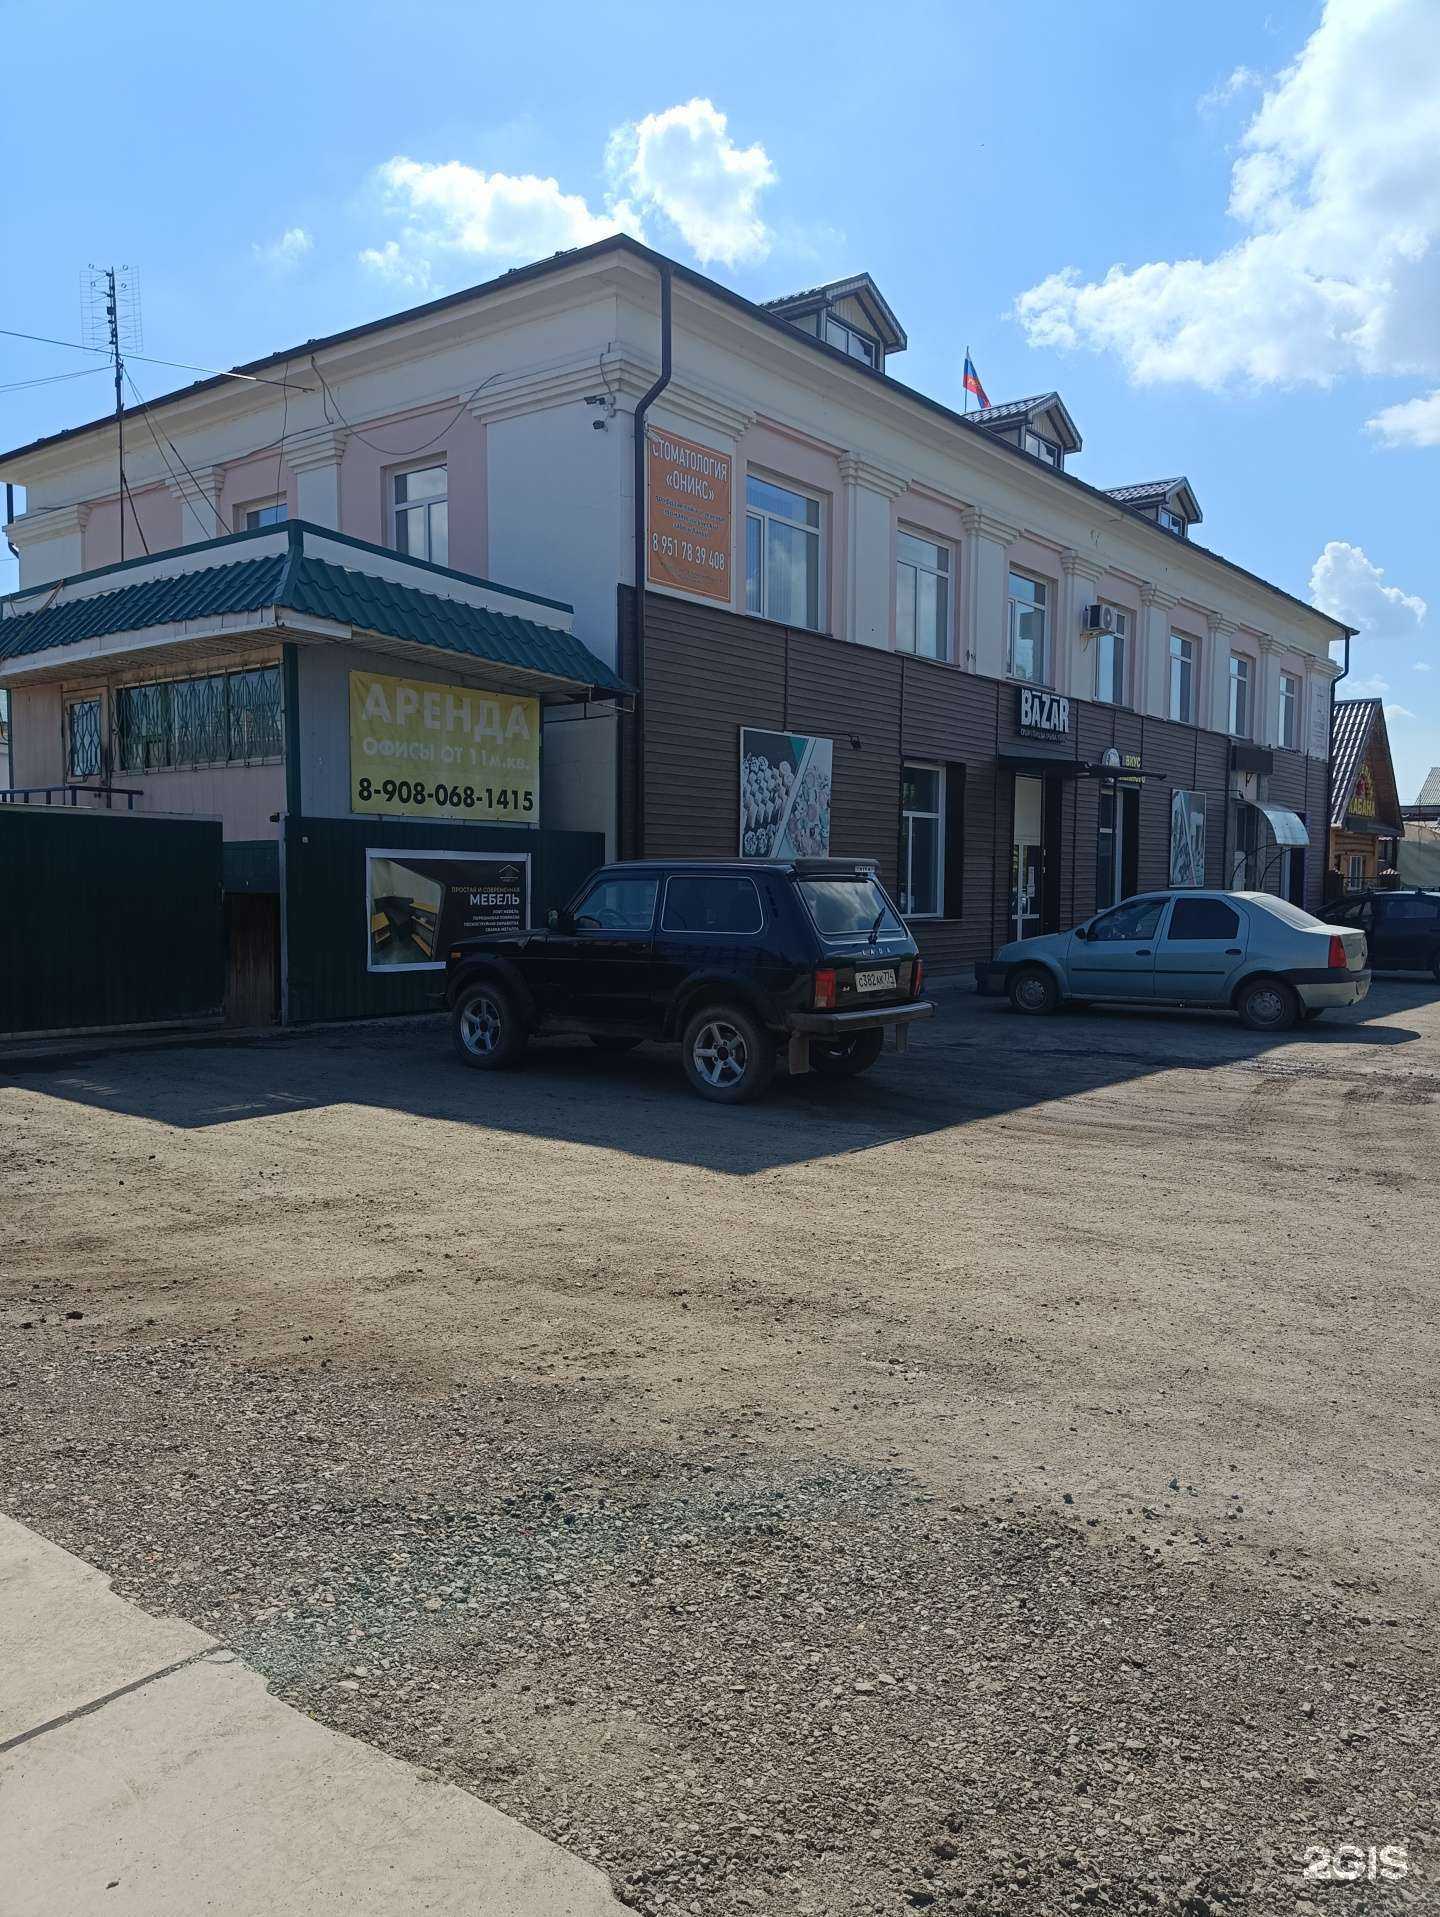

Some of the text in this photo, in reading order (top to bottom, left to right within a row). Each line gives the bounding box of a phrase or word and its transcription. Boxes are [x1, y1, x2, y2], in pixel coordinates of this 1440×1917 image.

[652, 437, 727, 482] СТОМАТОЛОГИЯ
[666, 470, 715, 501] «ОНИКС»
[652, 533, 725, 570] 8 951 78 39 408
[362, 683, 530, 744] АРЕНДА
[358, 777, 534, 812] 8-908-068-1415
[470, 893, 520, 906] МЕБЕЛЬ
